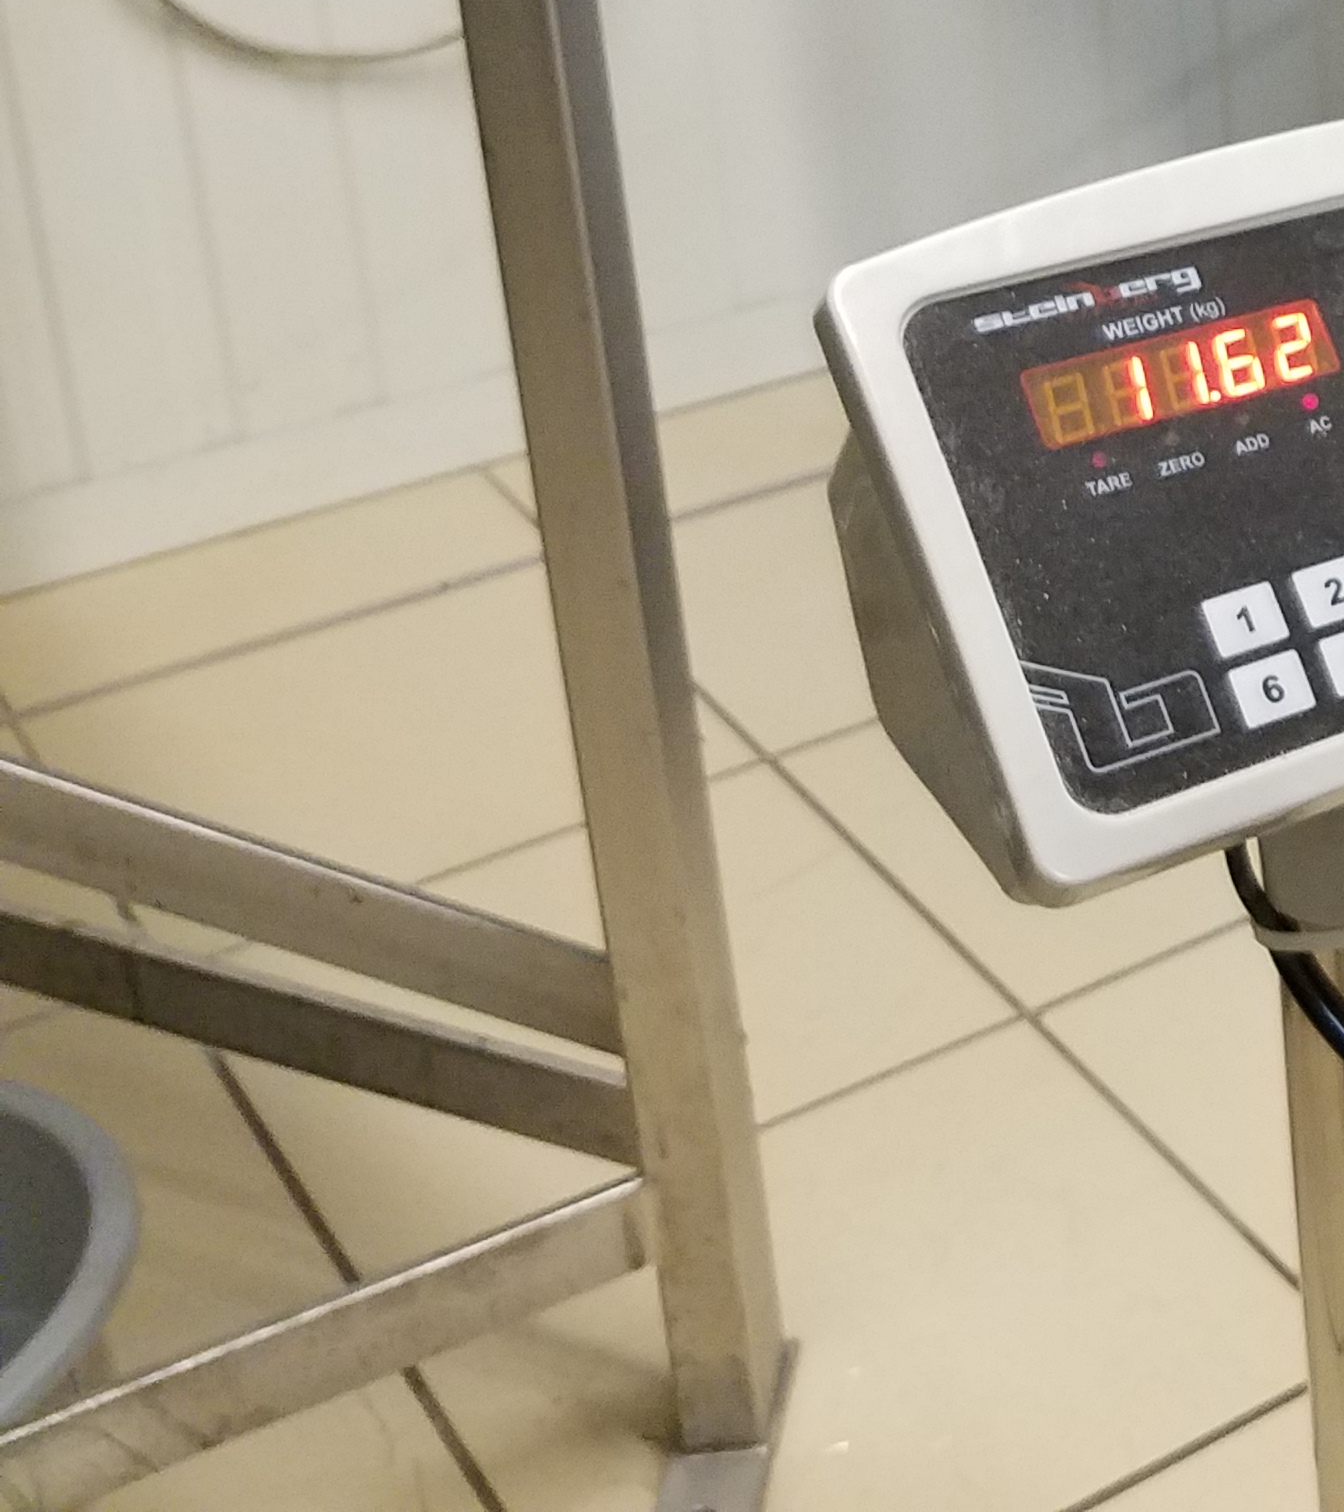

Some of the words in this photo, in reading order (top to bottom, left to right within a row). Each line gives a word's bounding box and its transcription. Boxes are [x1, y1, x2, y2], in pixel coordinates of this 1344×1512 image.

[1101, 304, 1184, 341] WEIGHT
[1189, 296, 1227, 324] (kg)
[1127, 312, 1315, 422] 11.62
[1308, 415, 1334, 436] AC
[1235, 433, 1271, 457] ADD
[1157, 451, 1207, 478] ZERO
[1085, 471, 1134, 498] TARE
[1236, 606, 1258, 634] 1
[1260, 675, 1286, 704] 6
